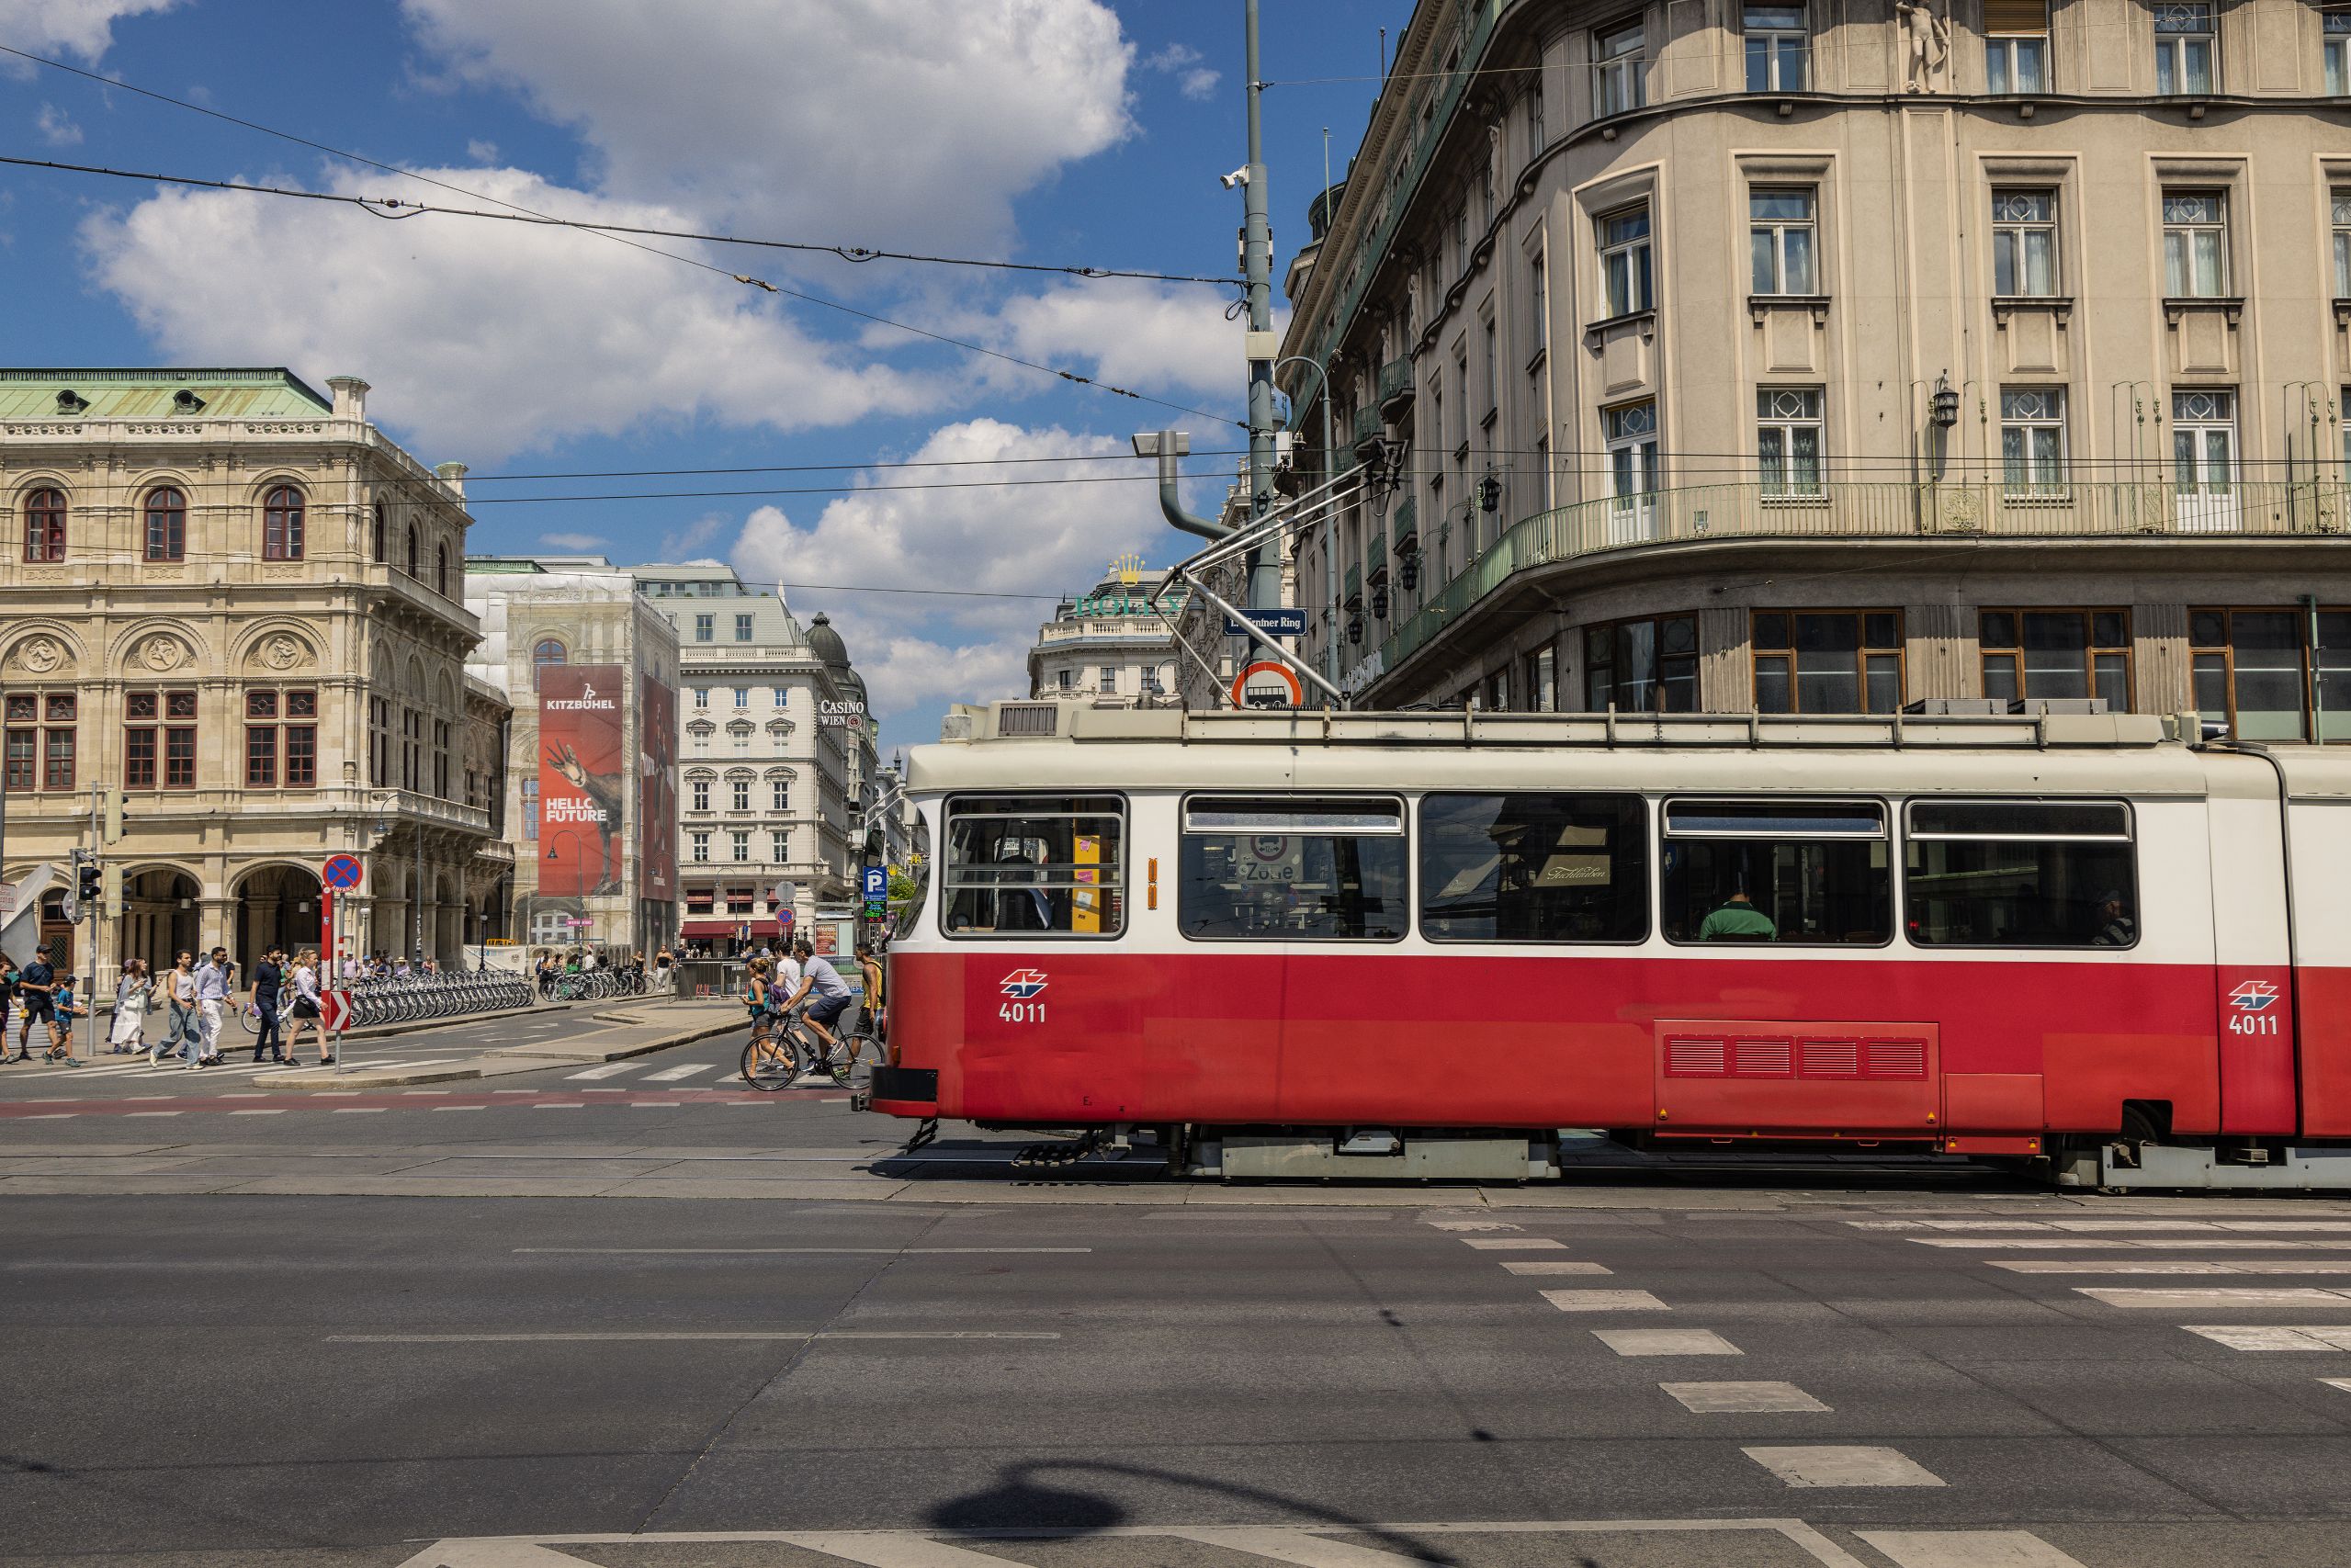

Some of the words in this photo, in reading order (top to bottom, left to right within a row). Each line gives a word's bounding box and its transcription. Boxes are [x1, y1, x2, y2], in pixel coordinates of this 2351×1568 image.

[1280, 616, 1301, 629] Ring
[821, 716, 845, 726] WIEN
[546, 809, 607, 822] FUTURE
[331, 885, 355, 893] ANFANG
[867, 874, 883, 893] P
[999, 1002, 1046, 1022] 4011
[2229, 1014, 2278, 1035] 4011
